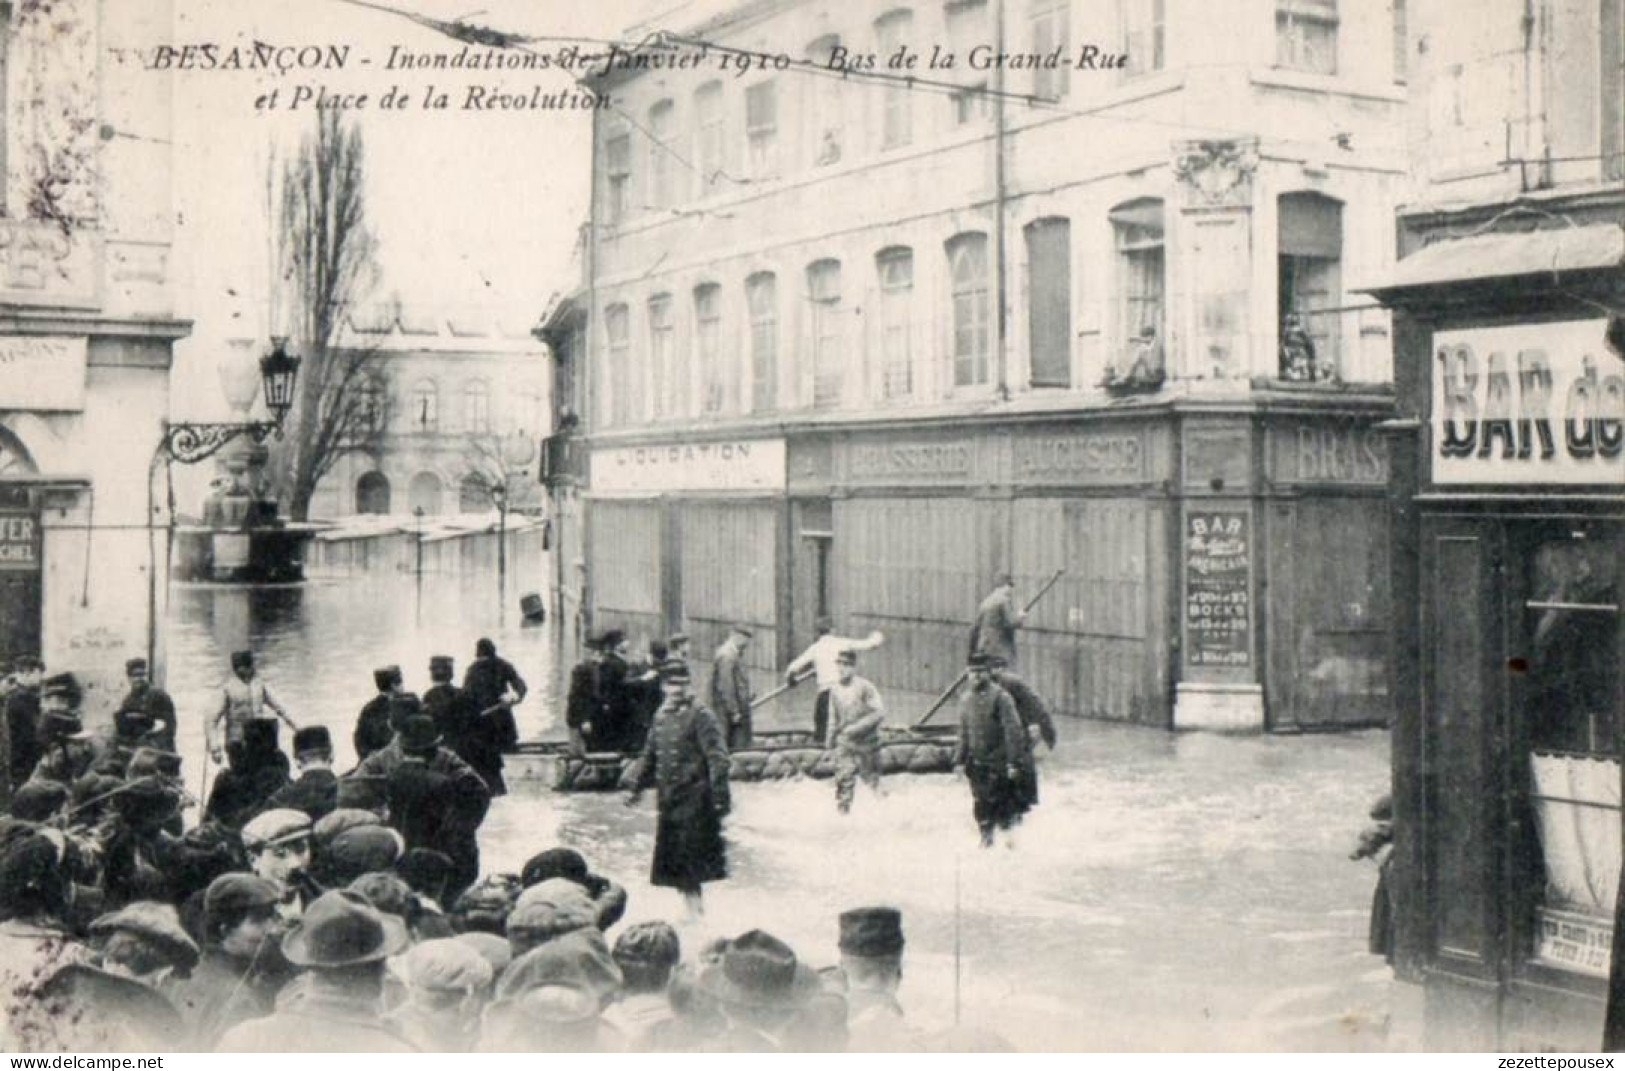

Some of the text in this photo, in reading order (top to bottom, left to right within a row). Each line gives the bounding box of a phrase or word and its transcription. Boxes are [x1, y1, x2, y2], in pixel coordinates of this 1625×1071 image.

[1437, 343, 1555, 460] BAR
[616, 444, 751, 466] LIQUIDATION
[1017, 436, 1138, 471] AUGUSTE
[1192, 515, 1242, 535] BAR
